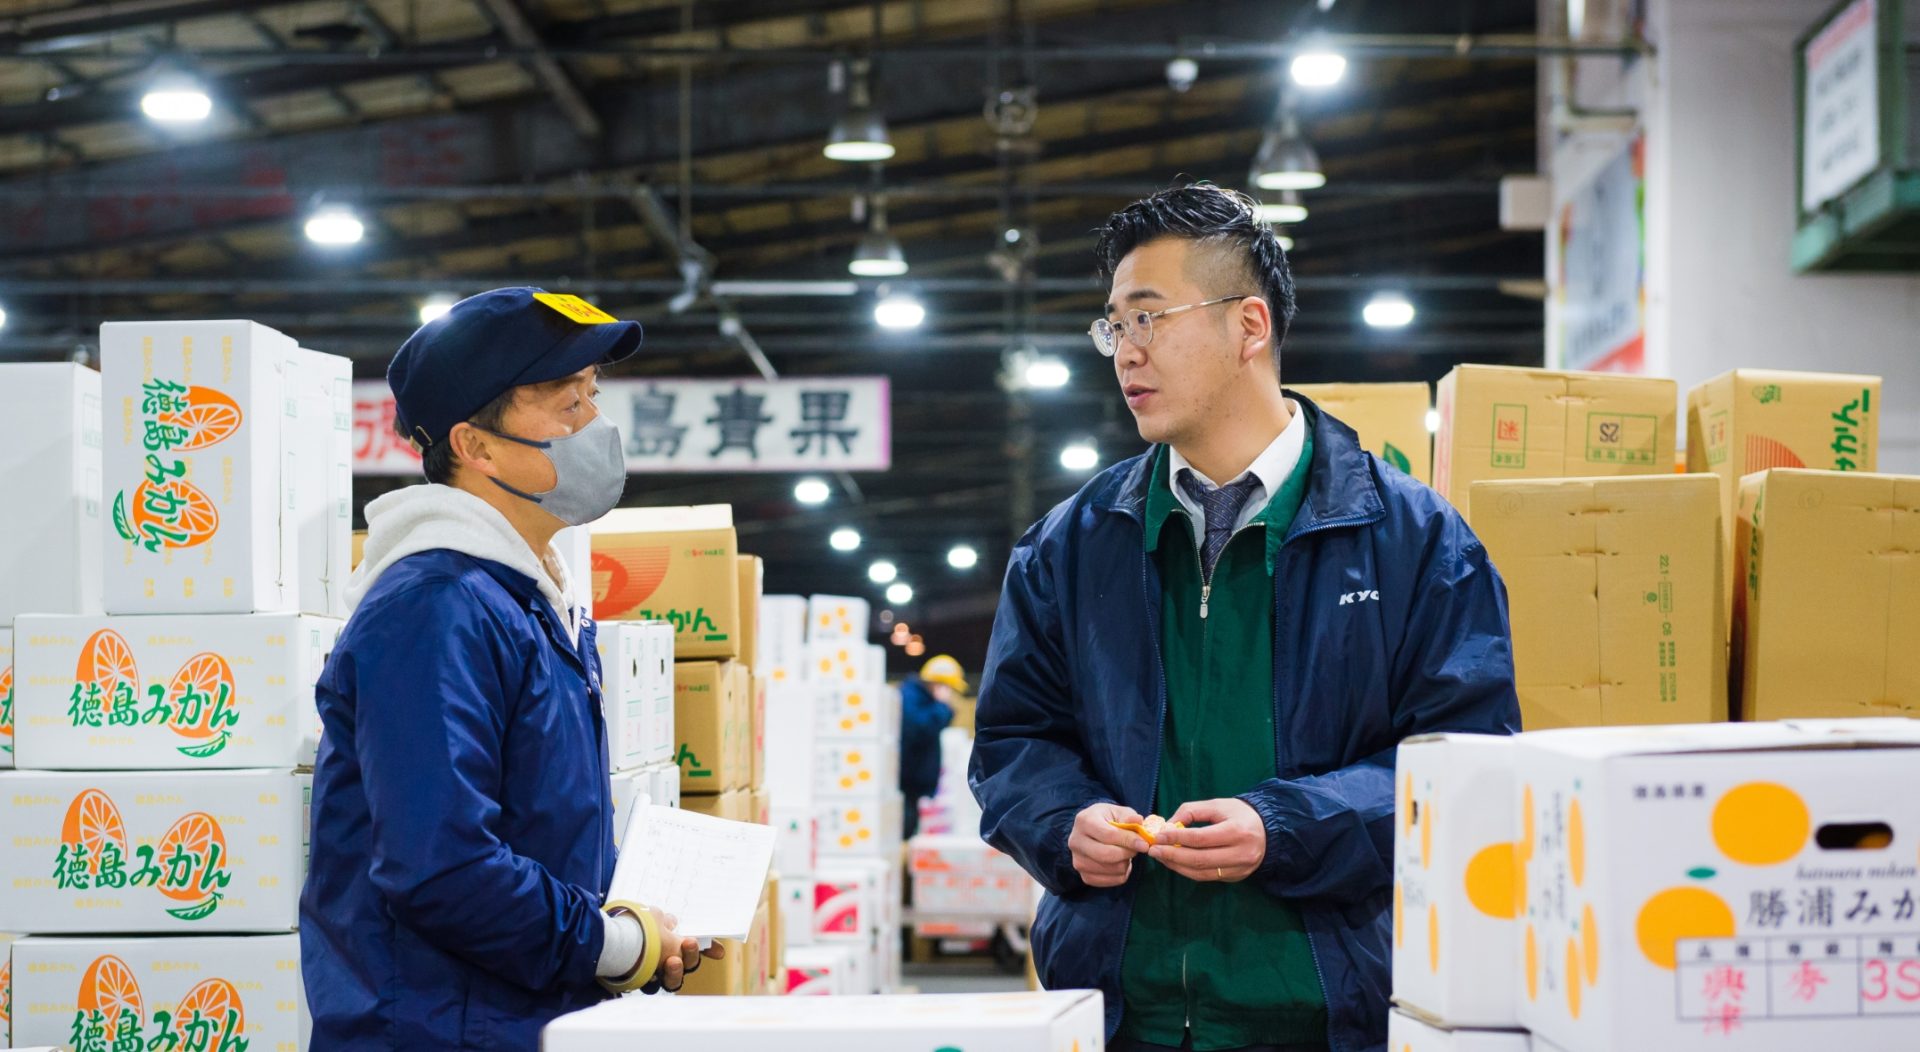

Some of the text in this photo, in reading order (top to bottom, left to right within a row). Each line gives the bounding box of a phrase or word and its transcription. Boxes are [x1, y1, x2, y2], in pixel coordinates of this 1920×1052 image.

[141, 377, 188, 553] 徳島みかん
[67, 681, 241, 728] 徳島みかん
[52, 842, 232, 890] 徳島みかん
[68, 1008, 250, 1052] 徳島みかん
